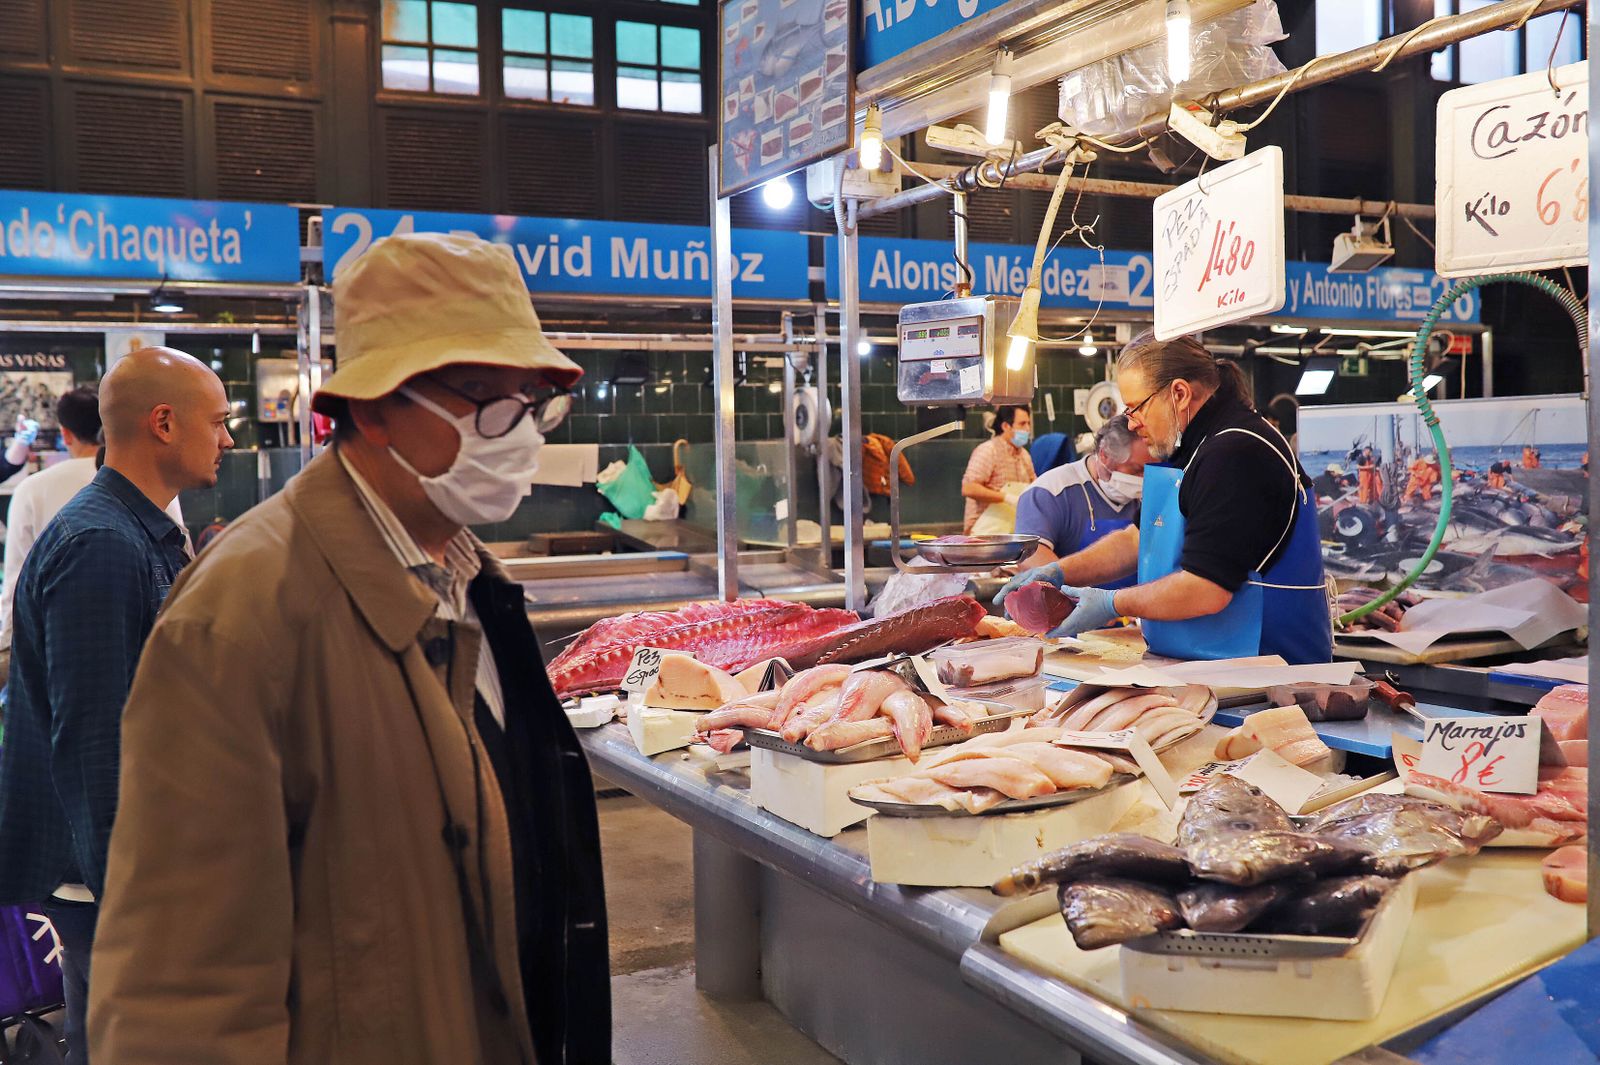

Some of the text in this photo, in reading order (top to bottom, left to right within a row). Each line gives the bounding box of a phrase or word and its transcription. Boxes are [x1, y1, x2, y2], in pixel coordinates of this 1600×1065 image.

[1162, 198, 1202, 248] PEZ
[1217, 290, 1245, 308] Kilo
[1290, 278, 1300, 313] y
[1303, 271, 1363, 307] Antonio
[1366, 275, 1412, 310] Flores
[1427, 721, 1527, 757] Marrajos
